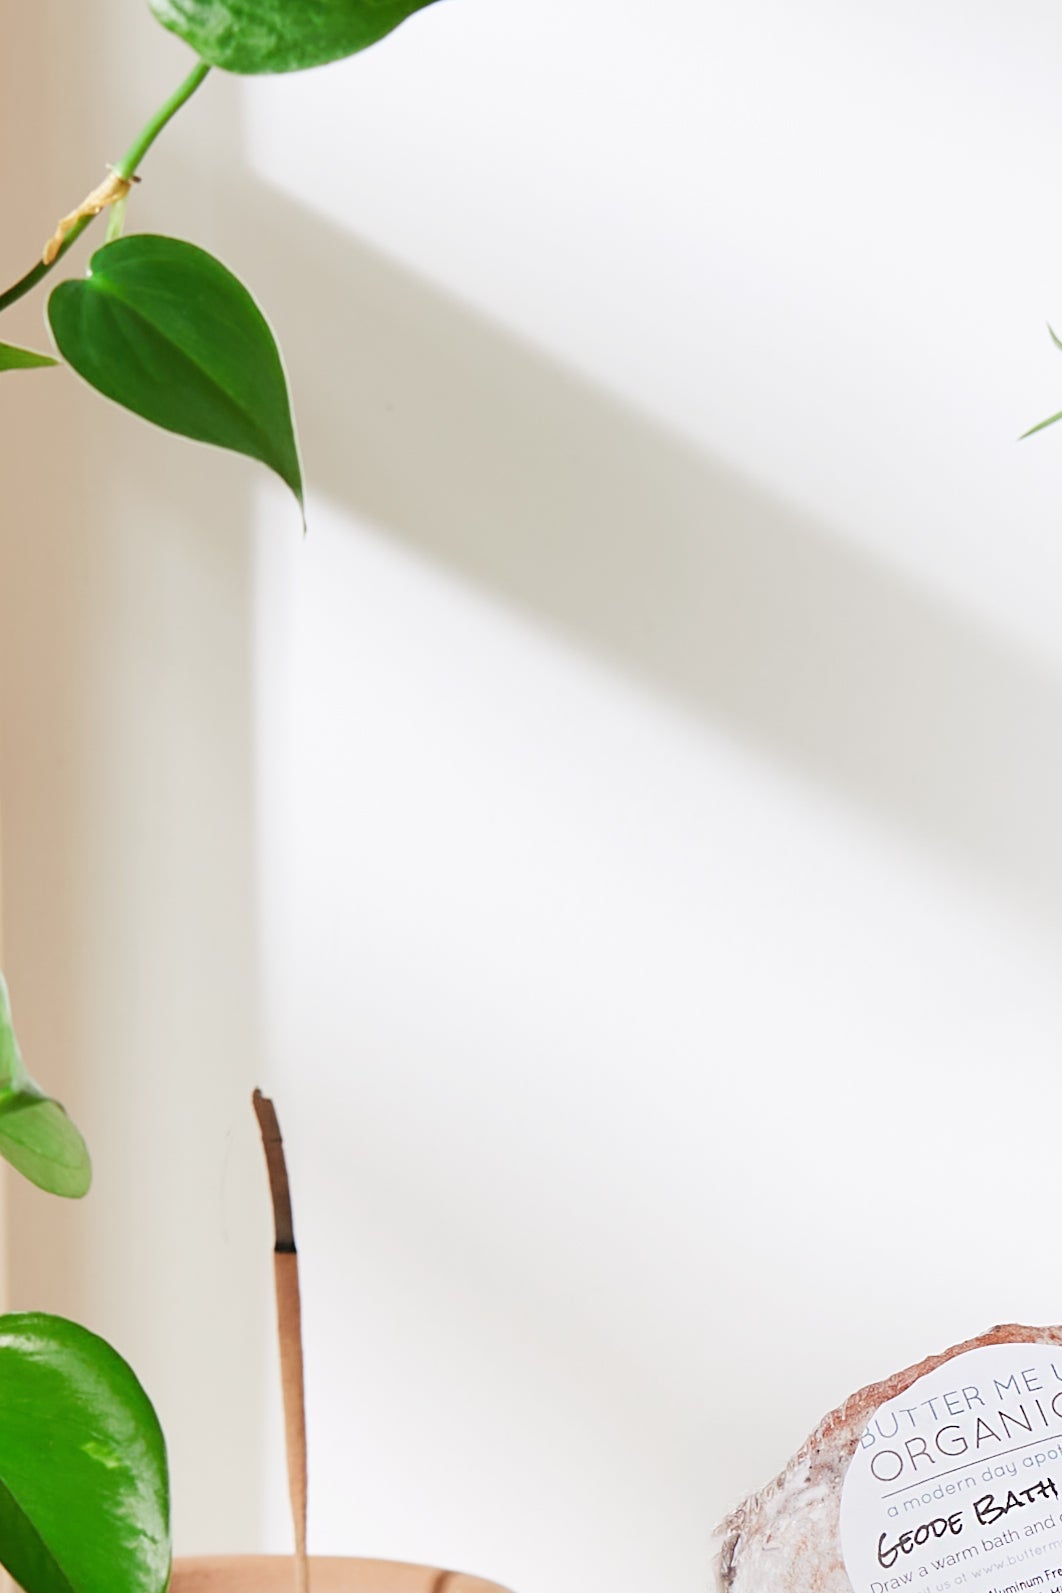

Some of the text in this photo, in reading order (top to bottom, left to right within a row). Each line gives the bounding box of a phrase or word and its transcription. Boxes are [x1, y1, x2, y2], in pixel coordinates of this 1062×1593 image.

[861, 1386, 985, 1449] BUTTER
[993, 1368, 1043, 1400] ME
[886, 1506, 898, 1518] a
[903, 1477, 976, 1512] modern
[982, 1462, 1018, 1481] day
[877, 1511, 963, 1568] GEODE
[973, 1477, 1058, 1525] BATH
[918, 1566, 929, 1577] a
[930, 1545, 980, 1571] warm
[981, 1528, 1020, 1552] bath
[1023, 1514, 1056, 1537] and
[936, 1580, 951, 1592] us
[954, 1574, 968, 1585] at
